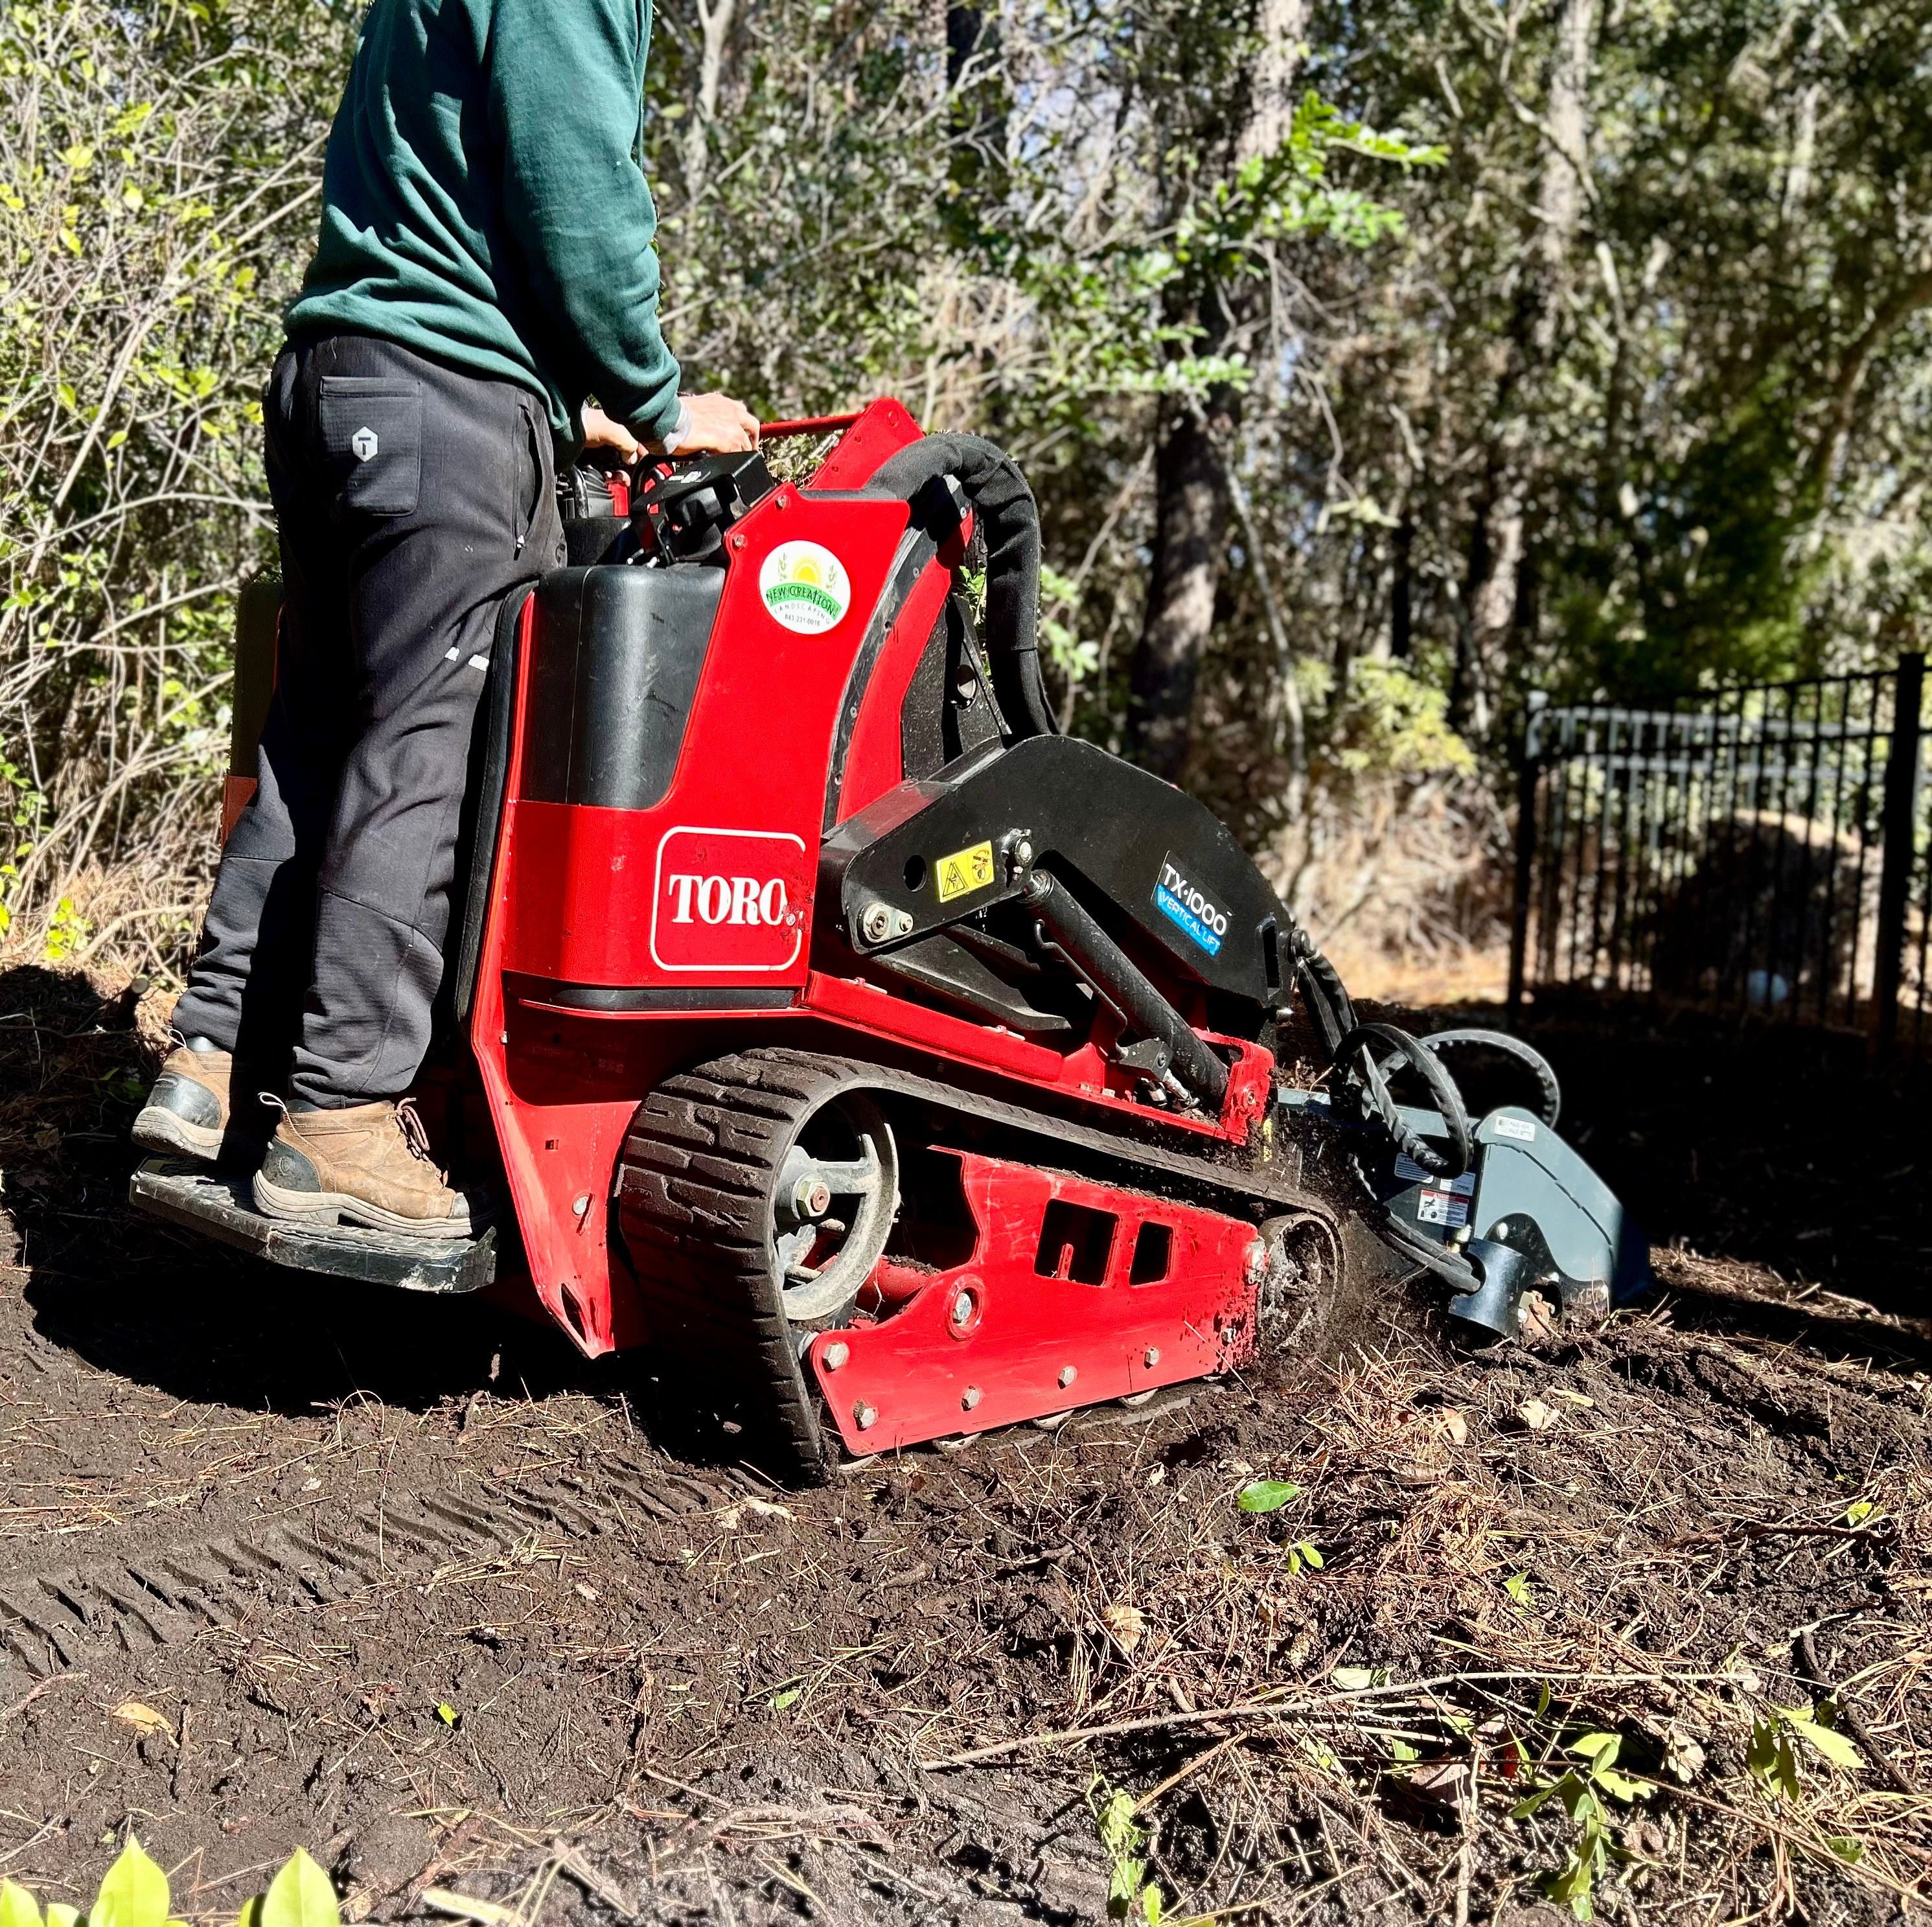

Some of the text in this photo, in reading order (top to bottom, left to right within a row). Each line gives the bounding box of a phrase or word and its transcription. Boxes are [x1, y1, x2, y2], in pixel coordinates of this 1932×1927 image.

[766, 586, 786, 601] NEW
[775, 603, 831, 624] LANDSCAPING
[669, 875, 788, 925] TORO
[1162, 893, 1221, 951] VERTICAL LIFT
